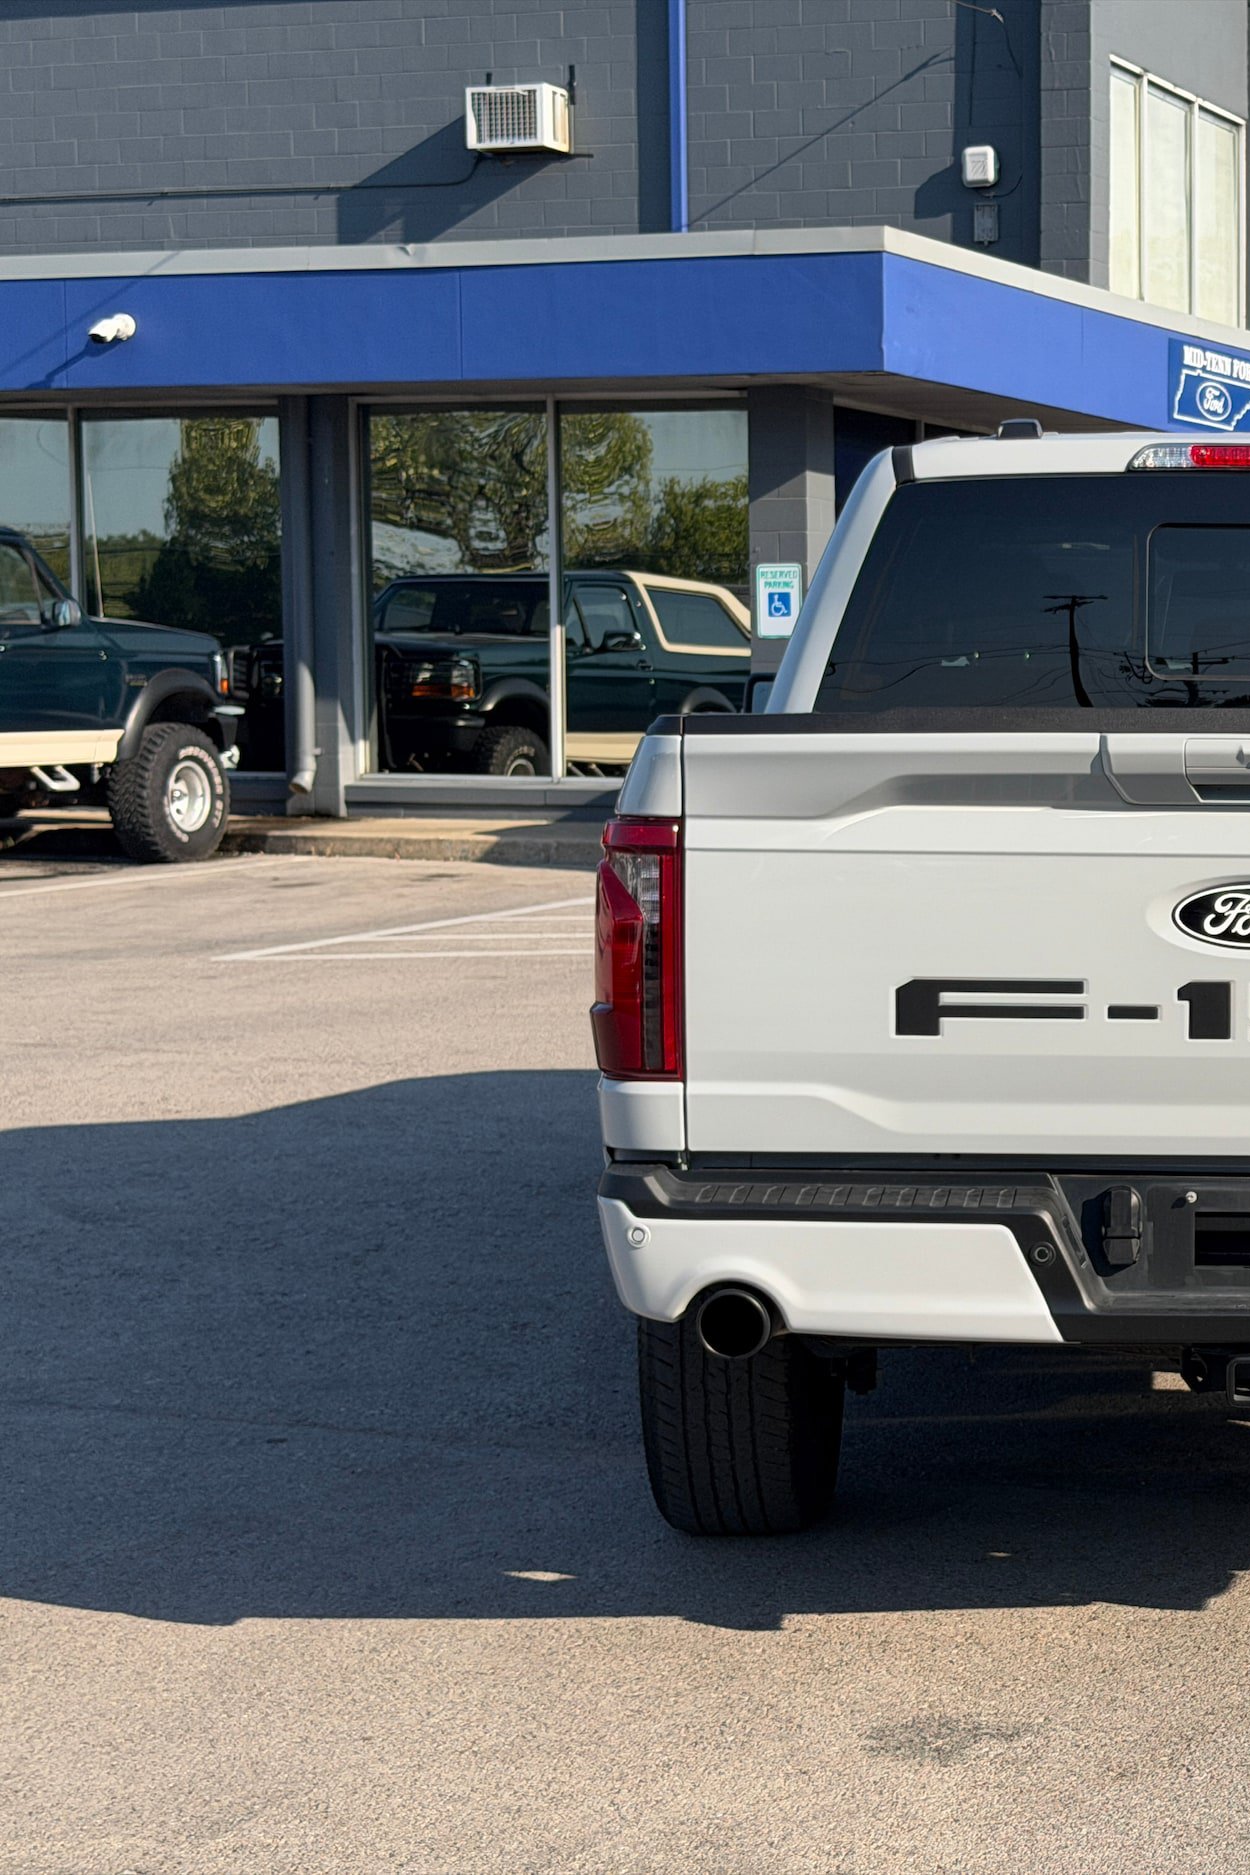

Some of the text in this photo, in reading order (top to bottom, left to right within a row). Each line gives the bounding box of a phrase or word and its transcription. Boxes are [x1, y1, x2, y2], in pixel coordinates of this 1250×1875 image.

[1203, 387, 1225, 414] Ford
[760, 570, 798, 579] RESERVED
[764, 580, 794, 589] PARKING
